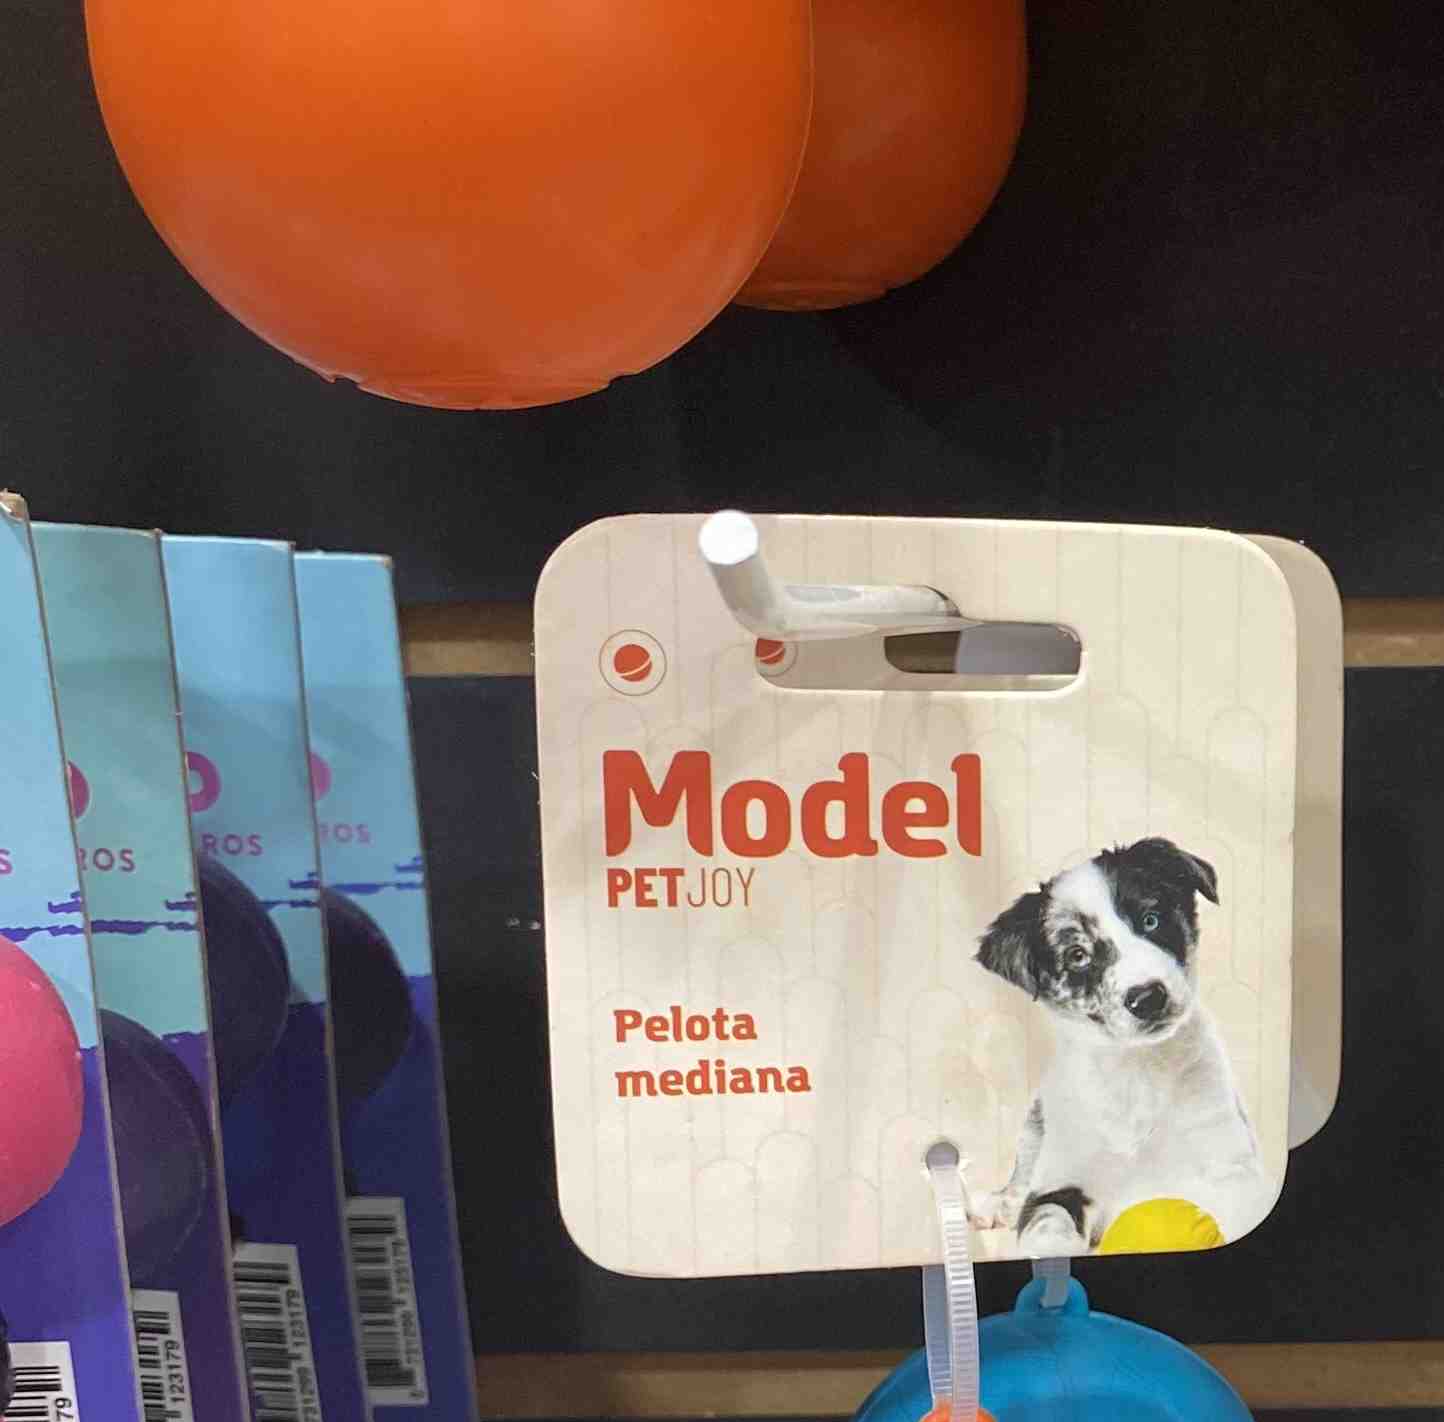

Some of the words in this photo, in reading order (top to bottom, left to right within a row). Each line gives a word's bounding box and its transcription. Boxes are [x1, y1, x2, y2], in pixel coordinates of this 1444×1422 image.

[602, 749, 982, 858] Model
[614, 1005, 755, 1043] Pelota
[616, 1060, 809, 1097] mediana
[165, 1340, 186, 1402] 123179
